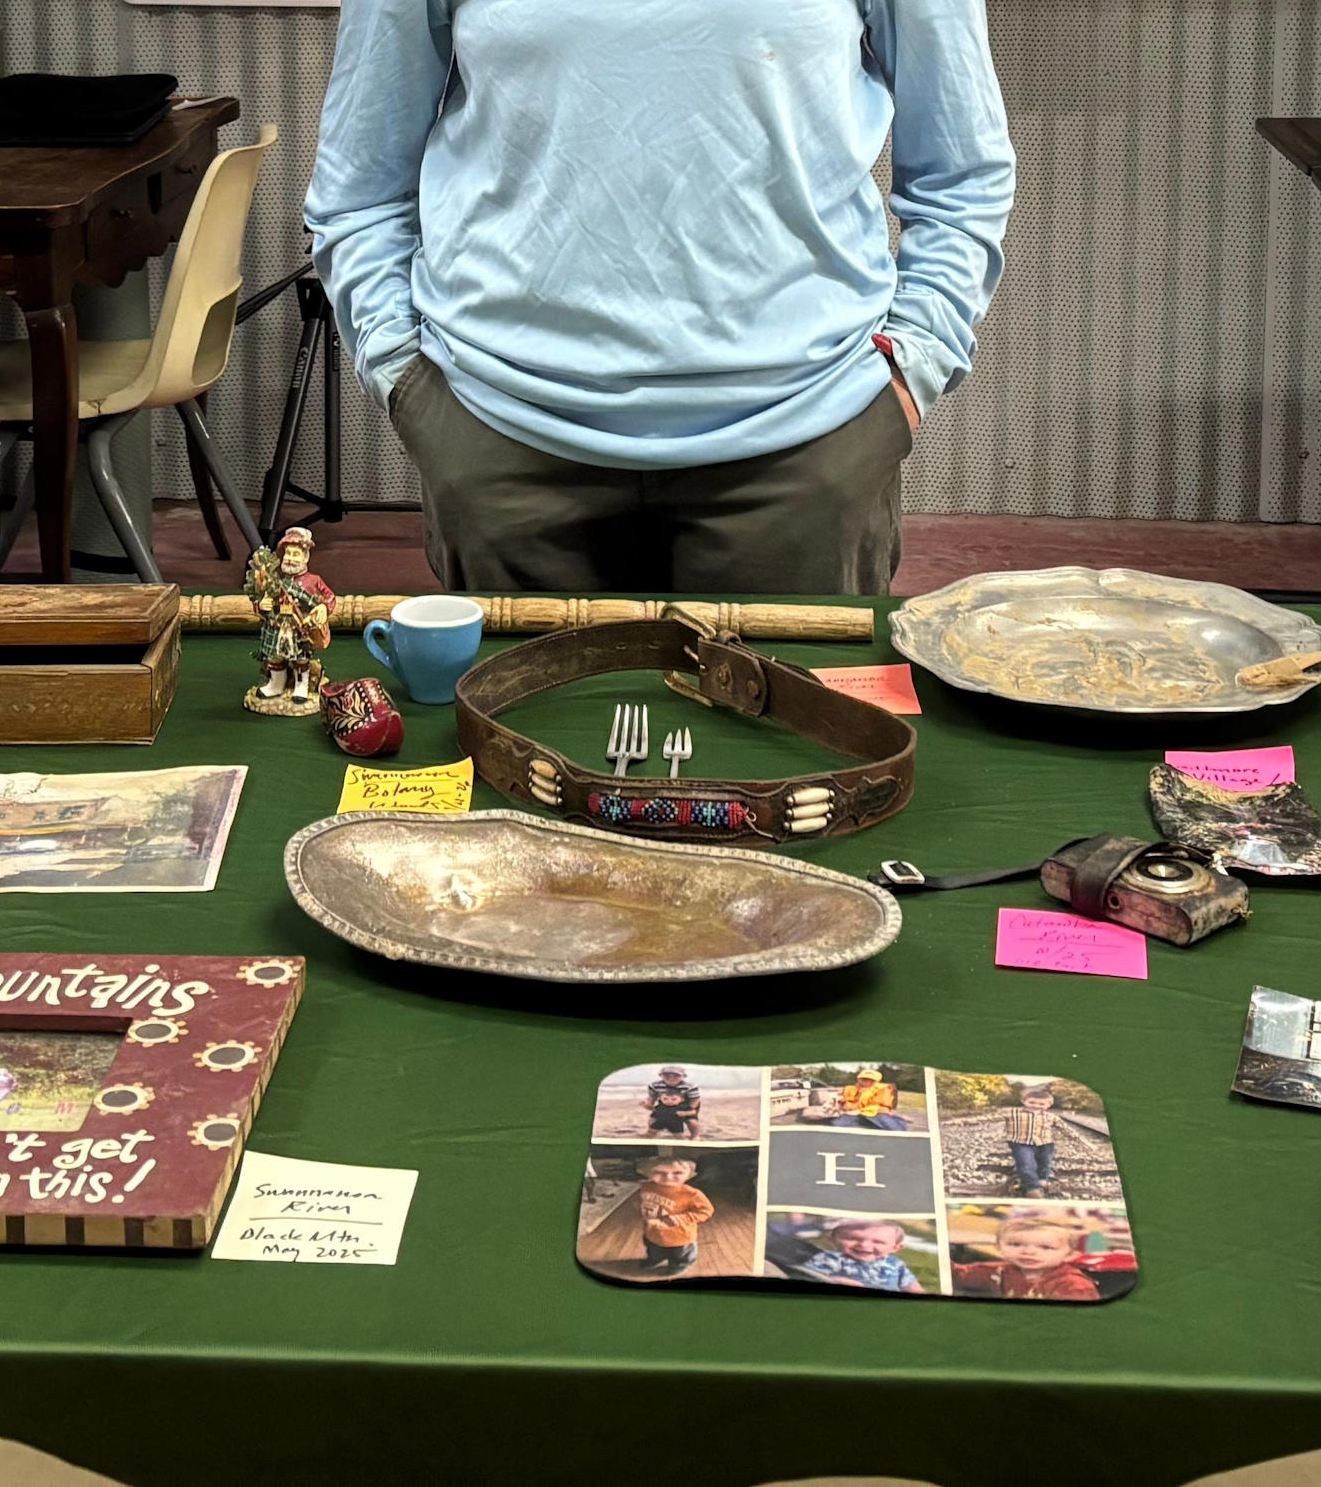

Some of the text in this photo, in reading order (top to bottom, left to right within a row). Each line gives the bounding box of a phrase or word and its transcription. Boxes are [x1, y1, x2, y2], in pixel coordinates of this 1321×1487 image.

[53, 1130, 155, 1169] get
[20, 1159, 157, 1204] this!
[816, 1152, 885, 1187] H
[262, 1244, 300, 1262] May
